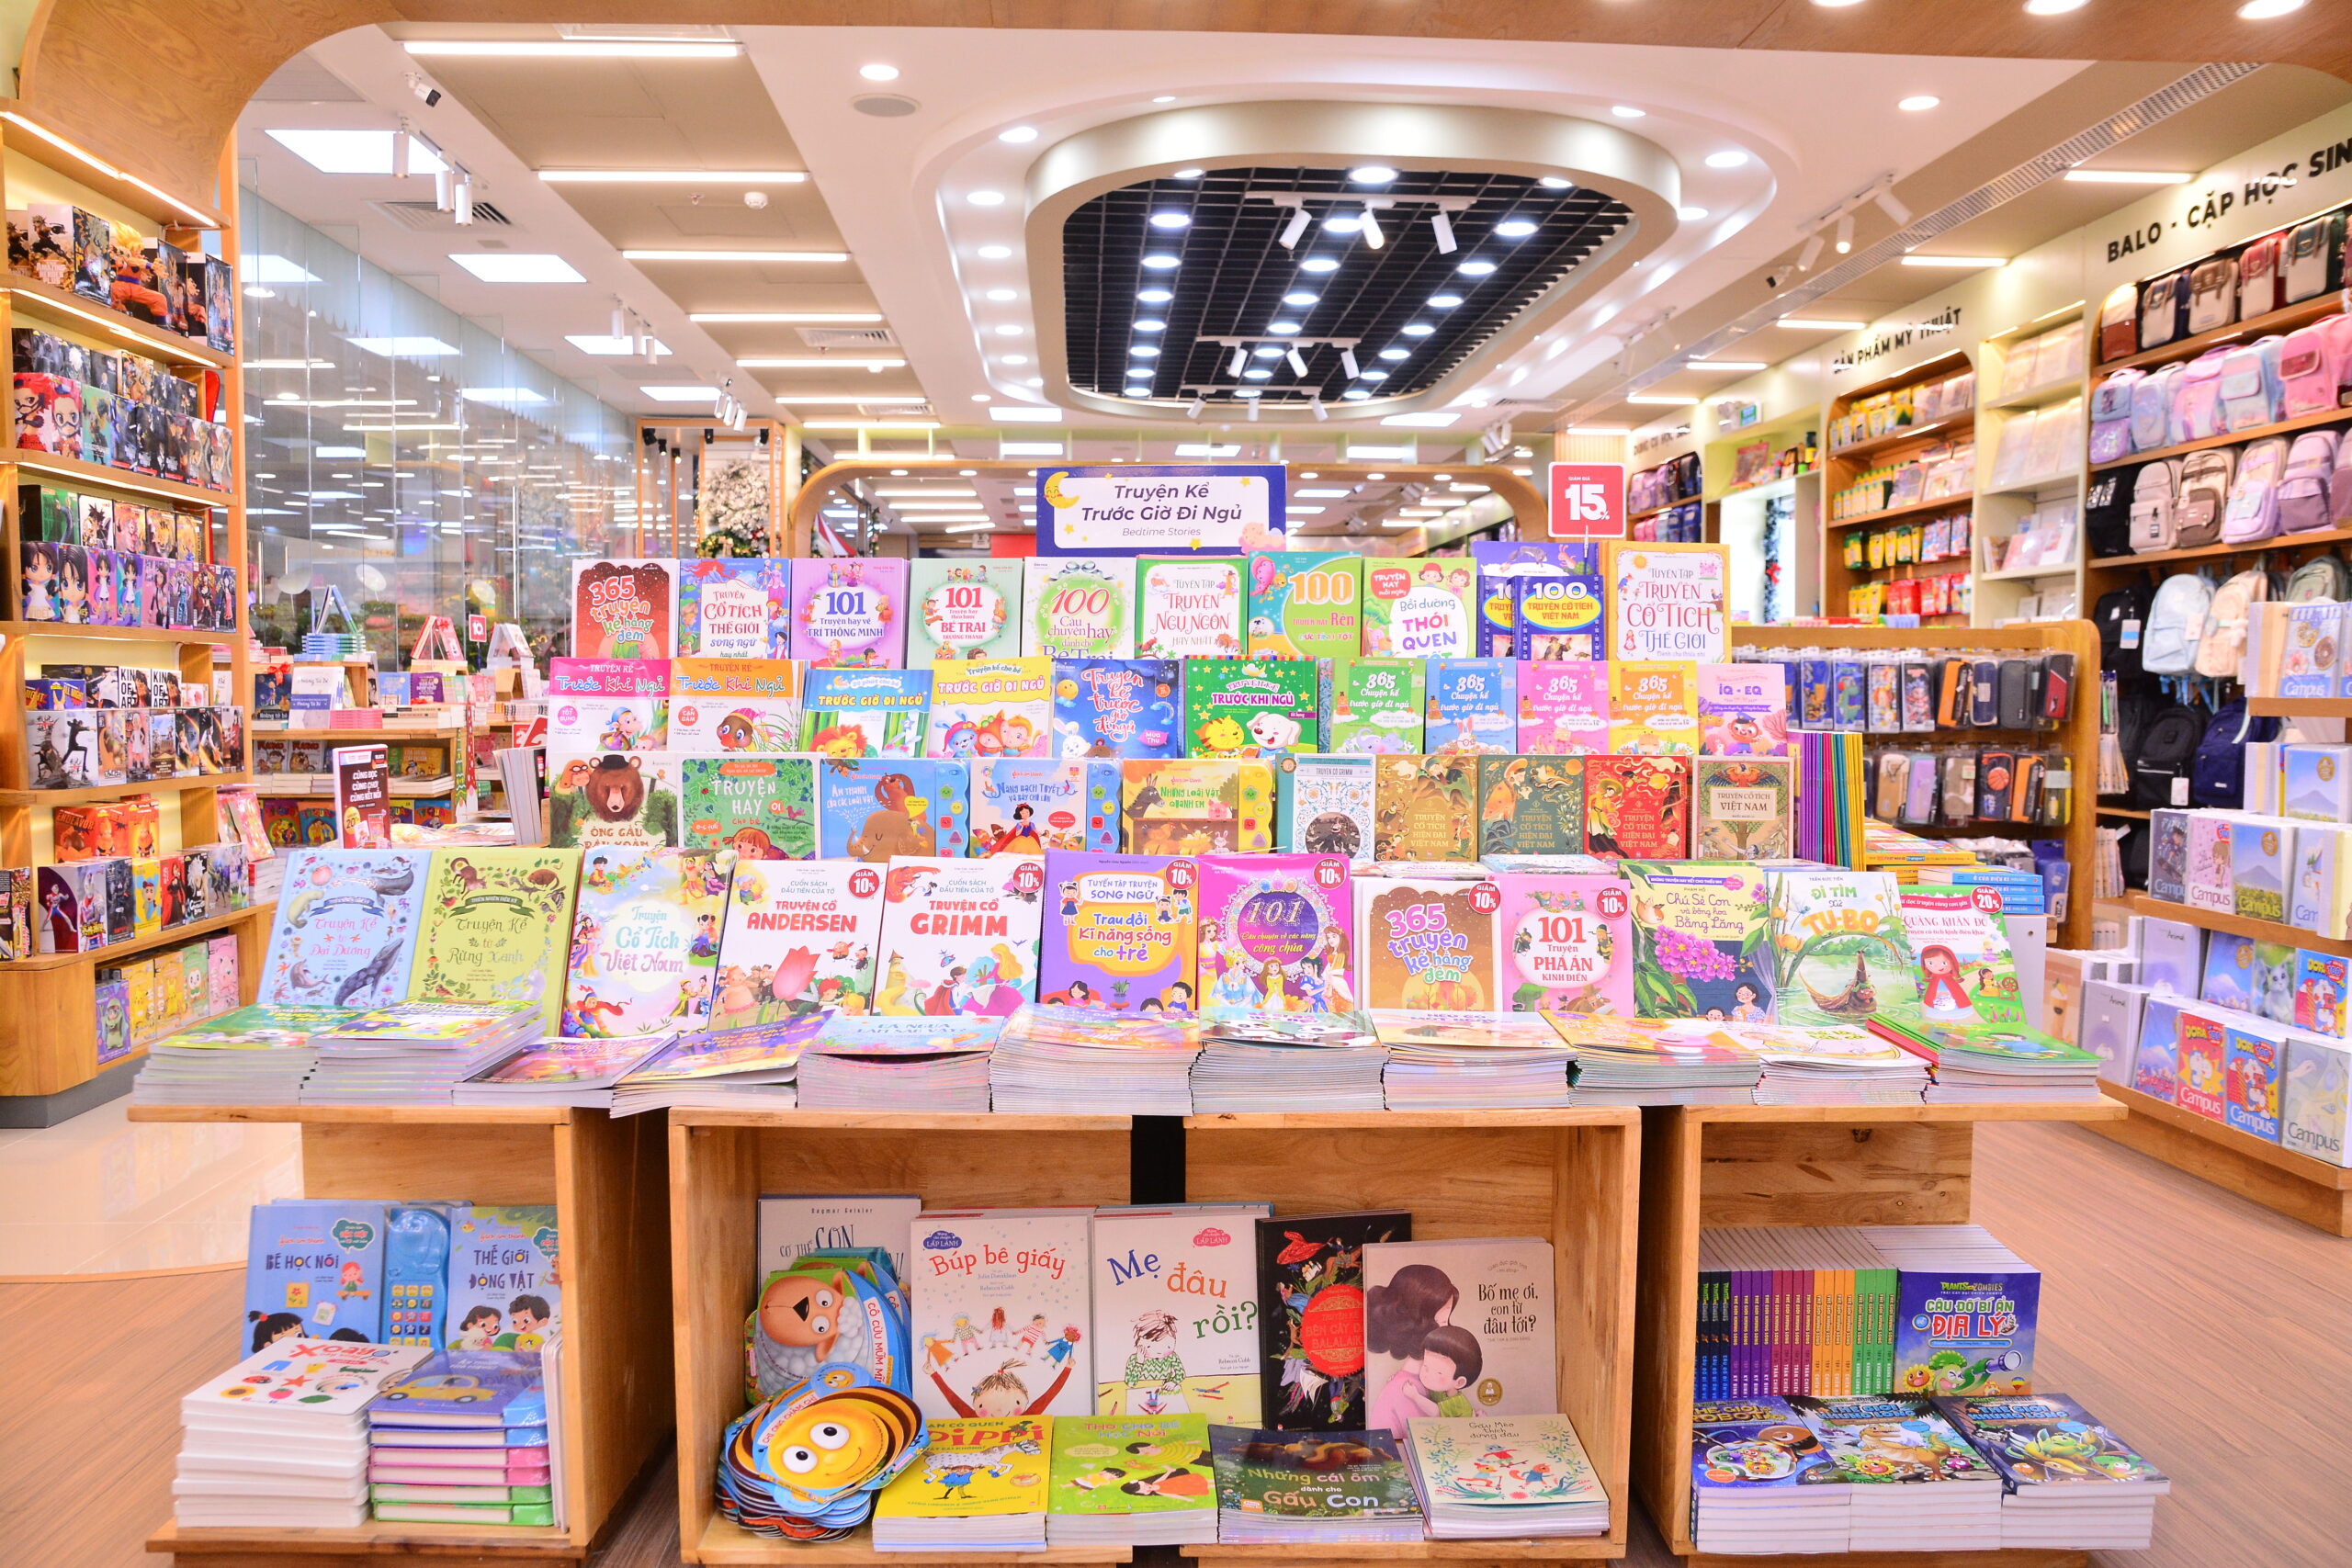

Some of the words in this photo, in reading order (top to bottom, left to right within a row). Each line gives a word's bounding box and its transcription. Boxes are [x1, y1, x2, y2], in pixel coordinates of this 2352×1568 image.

[2108, 221, 2159, 263] BALO
[2188, 191, 2233, 229] CẶP
[2245, 164, 2298, 206] HỌC
[1858, 333, 1890, 365] PHẨM
[1920, 306, 1961, 340] THUẬT
[1114, 485, 1178, 501] Truyện
[1185, 481, 1209, 498] Kể
[1082, 506, 1134, 521] Trước
[1140, 505, 1171, 520] Giờ
[1177, 505, 1196, 520] Đi
[1203, 504, 1242, 522] Ngủ
[1122, 527, 1165, 536] Bedtime
[1168, 527, 1201, 536] Stories
[945, 588, 982, 608] 101
[1532, 583, 1587, 600] 100
[826, 592, 865, 615] 101
[1051, 588, 1110, 615] 100
[704, 603, 727, 619] CỔ
[729, 603, 763, 618] TÍCH
[709, 621, 733, 635] THẾ
[735, 622, 759, 635] GIỚI
[849, 618, 861, 627] hay
[941, 620, 956, 633] BÉ
[959, 622, 985, 633] TRAI
[1060, 616, 1082, 626] Câu
[1402, 611, 1450, 632] THÓI
[808, 626, 822, 637] TRÍ
[824, 626, 861, 637] THÔNG
[863, 627, 883, 637] MINH
[1047, 626, 1085, 638] chuyện
[1087, 623, 1114, 640] hay
[1402, 632, 1456, 651] QUEN
[120, 669, 136, 682] KIN
[1366, 672, 1396, 689] 365
[556, 675, 600, 691] Trước
[605, 676, 631, 691] Khi
[636, 677, 664, 697] Ngủ
[2284, 682, 2324, 697] Campus
[732, 800, 763, 815] HAY
[1721, 802, 1742, 812] VIỆT
[1745, 803, 1767, 811] NAM
[591, 826, 615, 838] ÔNG
[618, 824, 642, 838] GẤU
[855, 870, 874, 878] GIẢM
[1019, 872, 1039, 887] 10%
[1088, 878, 1113, 887] TUYỂN
[1129, 880, 1158, 888] TRUYỆN
[854, 878, 875, 894] 10%
[1091, 890, 1123, 899] SONG
[1127, 889, 1154, 899] NGỮ
[1830, 884, 1857, 897] TÌM
[775, 900, 820, 913] TRUYỆN
[822, 898, 837, 911] CỔ
[930, 899, 977, 913] TRUYỆN
[979, 897, 999, 911] CỔ
[1667, 893, 1690, 905] Chú
[1692, 894, 1705, 905] Sẻ
[1709, 894, 1731, 906] Con
[1977, 895, 1999, 908] 20%
[2191, 886, 2231, 907] Campus
[1094, 914, 1123, 925] Trau
[1126, 912, 1148, 927] dồi
[1246, 898, 1305, 923] 101
[747, 913, 856, 932] ANDERSEN
[910, 913, 1008, 936] GRIMM
[1385, 904, 1447, 939] 365
[1538, 917, 1586, 942] 101
[1675, 916, 1709, 933] Bằng
[1712, 917, 1744, 934] Lăng
[1800, 909, 1879, 936] TU-BO
[616, 926, 641, 949] Cổ
[645, 925, 680, 949] Tích
[1098, 929, 1133, 945] năng
[1136, 926, 1170, 946] sống
[1387, 930, 1468, 958] truyện
[1094, 946, 1114, 956] cho
[1116, 943, 1148, 961] trẻ
[1547, 944, 1577, 953] Truyện
[1403, 950, 1430, 975] kể
[1534, 952, 1566, 971] PHÁ
[1569, 952, 1592, 971] ÁN
[1423, 966, 1462, 982] đêm
[1543, 973, 1564, 981] KINH
[1566, 971, 1587, 982] ĐIỂN
[2180, 1086, 2222, 1115] Campus
[2231, 1104, 2276, 1135] Campus
[2288, 1122, 2340, 1152] Campus
[266, 1253, 280, 1270] BÉ
[286, 1254, 311, 1270] HỌC
[474, 1245, 498, 1265] THẾ
[929, 1250, 977, 1276] Búp
[986, 1246, 1008, 1264] bê
[1016, 1247, 1066, 1280] giấy
[1107, 1249, 1161, 1286] Mẹ
[469, 1273, 504, 1290] ĐỘNG
[510, 1270, 534, 1291] VẬT
[1167, 1262, 1227, 1298] đâu
[1973, 1282, 2002, 1292] ZOMBIES
[1478, 1283, 1497, 1301] Bố
[1499, 1286, 1518, 1303] mẹ
[1491, 1303, 1509, 1314] con
[1512, 1301, 1522, 1314] từ
[1926, 1299, 1952, 1313] CÂU
[1956, 1295, 1976, 1313] ĐỐ
[1979, 1297, 1993, 1312] BÍ
[1995, 1295, 2014, 1313] ẨN
[1193, 1301, 1258, 1338] rồi?
[1484, 1317, 1507, 1334] đâu
[1512, 1314, 1536, 1333] tới?
[1933, 1315, 1969, 1340] ĐỊA
[1979, 1313, 2004, 1337] LÝ
[1248, 1468, 1311, 1485] Những
[1317, 1471, 1346, 1483] cái
[1351, 1470, 1380, 1483] ôm
[1264, 1492, 1317, 1508] Gấu
[1327, 1494, 1379, 1508] Con
